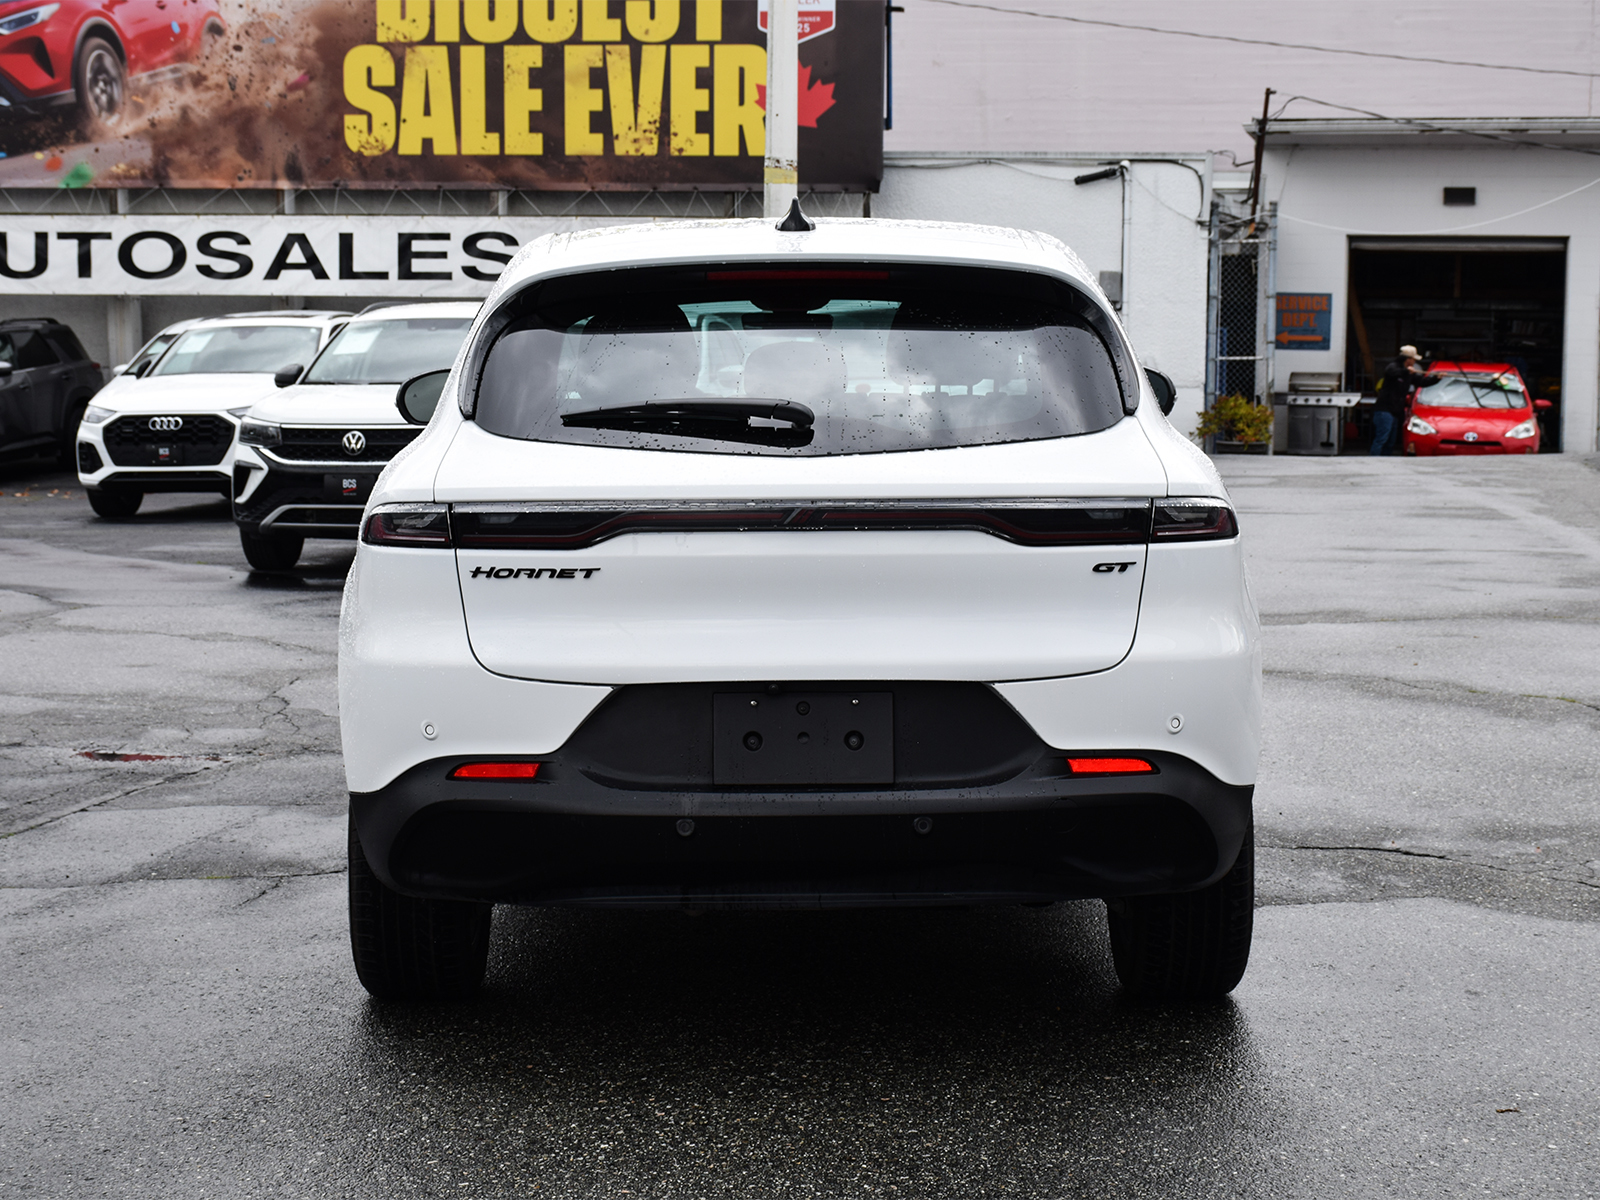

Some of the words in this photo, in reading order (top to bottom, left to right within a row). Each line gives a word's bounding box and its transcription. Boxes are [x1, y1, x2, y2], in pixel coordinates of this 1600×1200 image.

[343, 44, 543, 156] SALE
[564, 44, 767, 156] EVER
[0, 230, 519, 281] UTOSALES
[1282, 312, 1318, 328] DEPT.
[342, 478, 357, 489] BCS
[469, 566, 601, 579] HORNET
[1092, 561, 1137, 573] GT
